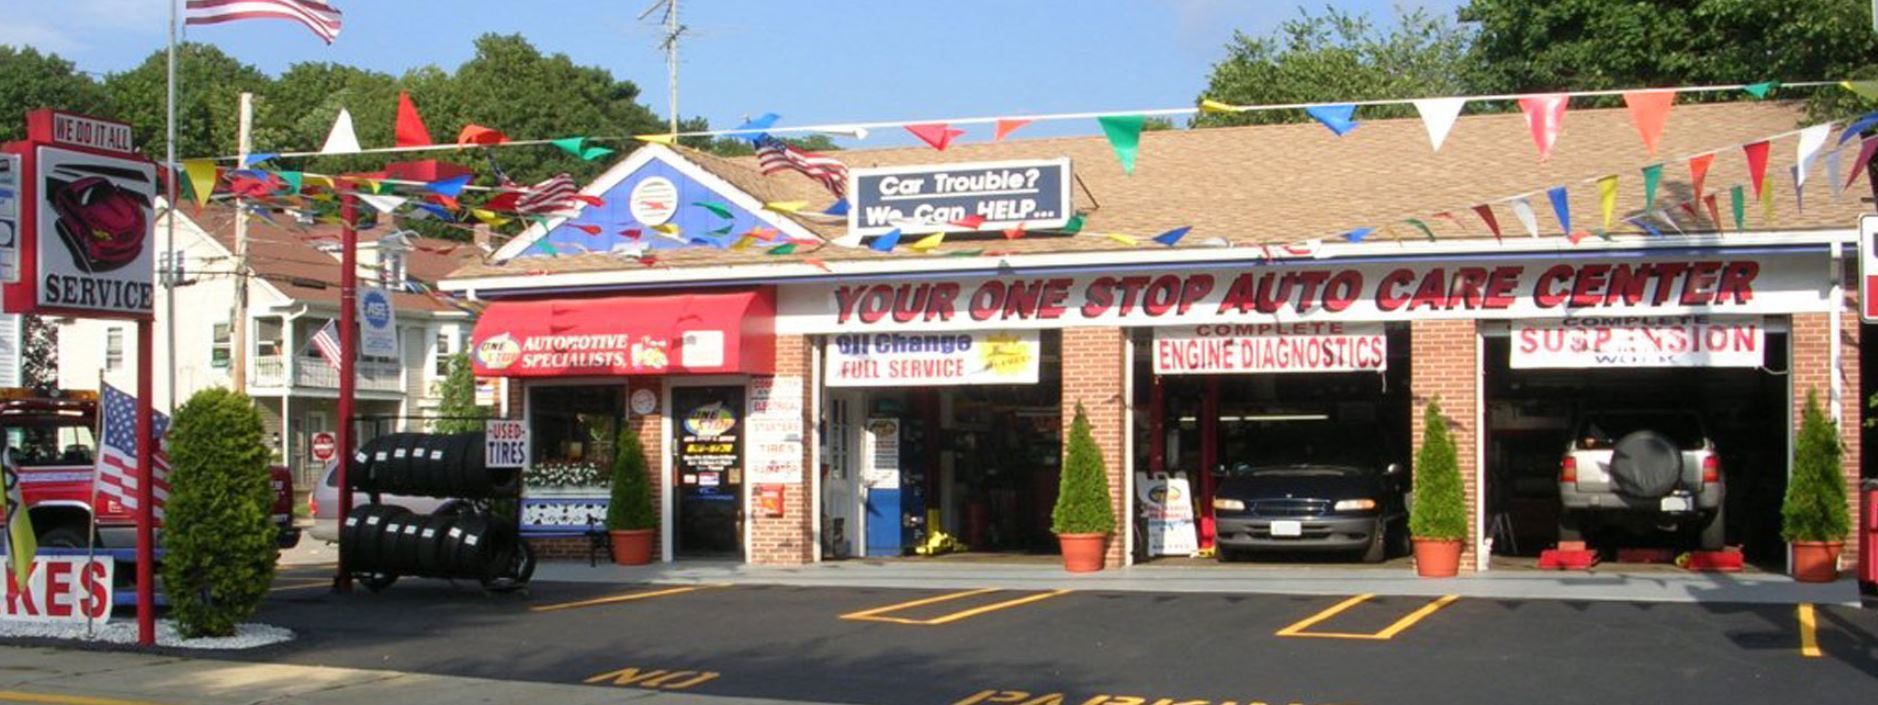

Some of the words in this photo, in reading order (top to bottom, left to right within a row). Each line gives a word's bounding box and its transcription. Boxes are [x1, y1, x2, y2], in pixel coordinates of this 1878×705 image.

[56, 116, 74, 141] WE
[76, 119, 91, 144] DO
[92, 121, 108, 147] IT
[109, 124, 130, 151] ALL
[879, 176, 924, 195] Car
[934, 169, 1040, 193] Trouble?
[866, 206, 903, 226] We
[914, 203, 966, 225] Can
[45, 274, 154, 311] SERVICE
[834, 282, 961, 325] YOUR
[967, 277, 1073, 321] ONE
[1080, 273, 1214, 319] STOP
[1216, 268, 1364, 317] AUTO
[1375, 264, 1524, 312] CARE
[1532, 260, 1760, 310] CENTER
[1196, 321, 1343, 337] COMPLETE
[1562, 314, 1710, 328] COMPLETE
[522, 334, 629, 351] AUTOMOTIVE
[875, 333, 972, 354] Change
[1520, 324, 1756, 353] SUSPNSION
[1159, 339, 1234, 370] ENGINE
[1241, 336, 1382, 369] DIAGNOSTICS
[841, 359, 880, 378] FULL
[889, 358, 964, 378] SERVICE
[488, 441, 526, 465] TIRES
[585, 667, 721, 690] NO
